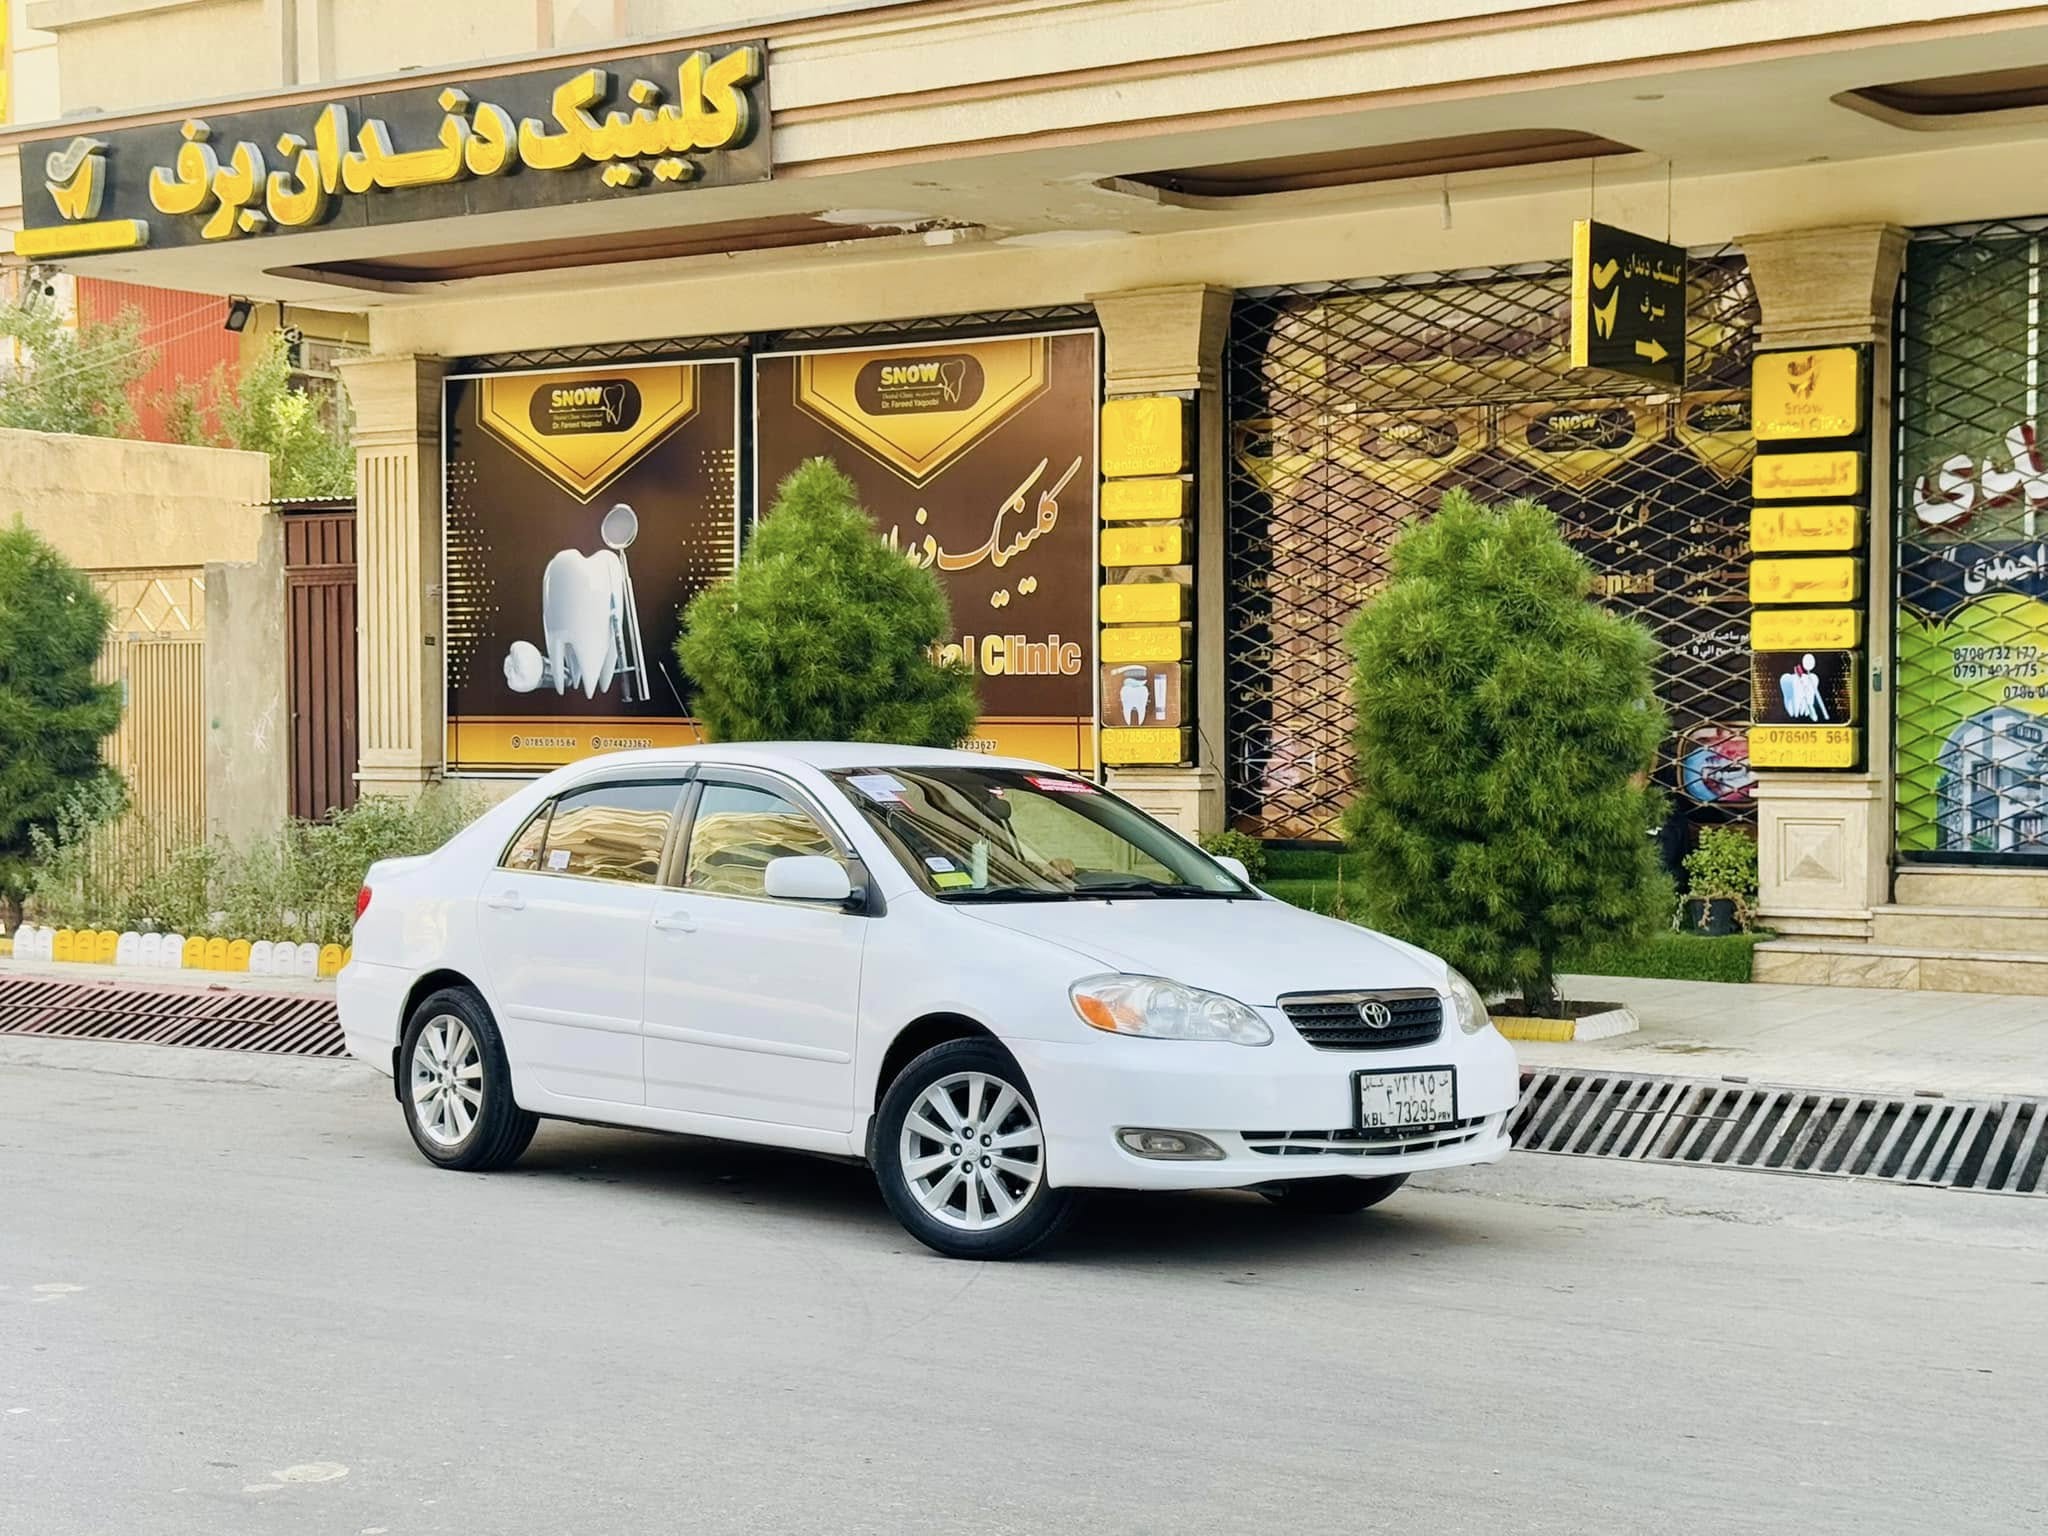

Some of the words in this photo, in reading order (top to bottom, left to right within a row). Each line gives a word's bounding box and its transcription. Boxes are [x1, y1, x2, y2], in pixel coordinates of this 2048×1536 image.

[519, 46, 761, 188] کلینیک
[267, 87, 518, 226] دندان
[149, 118, 265, 239] برف
[880, 362, 940, 385] SNOW
[551, 386, 603, 407] SNOW
[938, 456, 1082, 608] کلینیک
[981, 635, 1081, 675] Clinic
[1953, 664, 1983, 678] 0791
[1363, 1111, 1386, 1127] KBL
[1395, 1099, 1437, 1124] 73295
